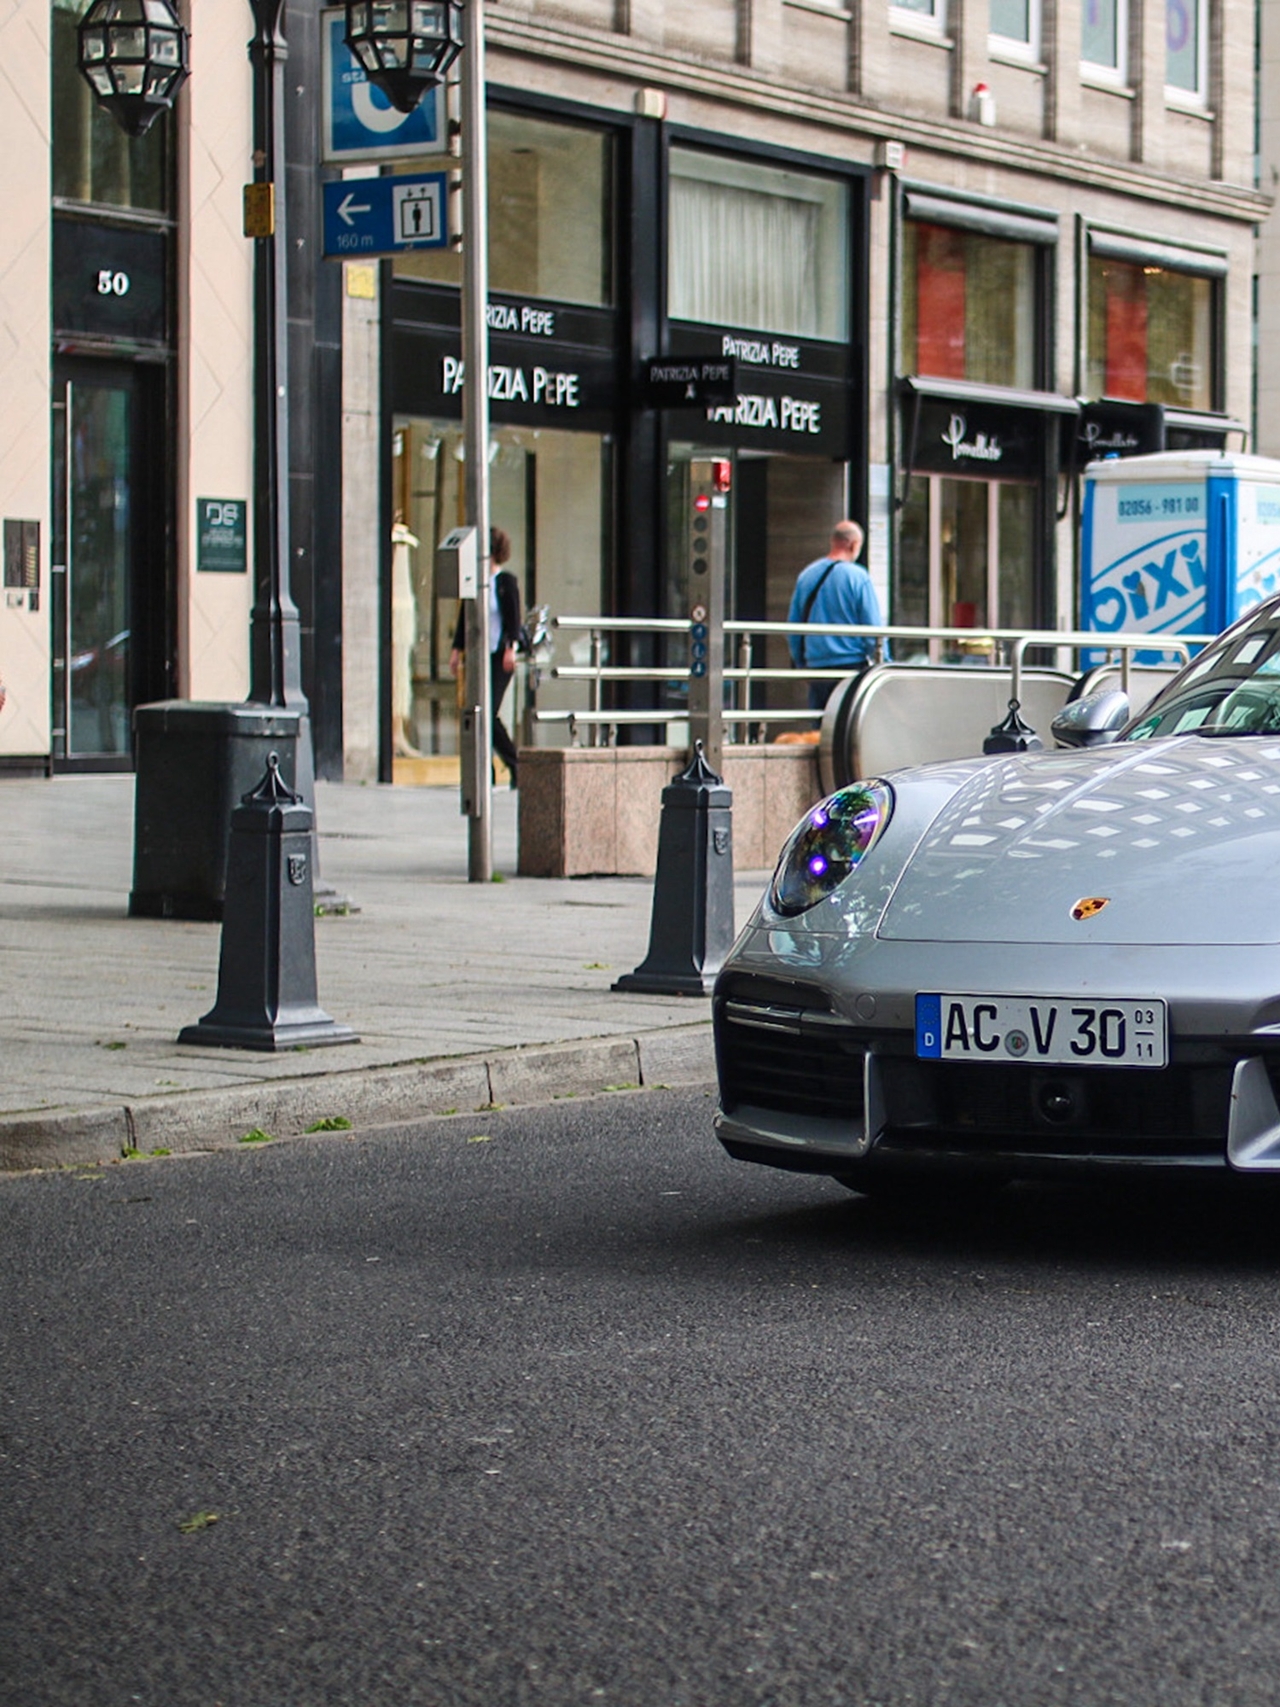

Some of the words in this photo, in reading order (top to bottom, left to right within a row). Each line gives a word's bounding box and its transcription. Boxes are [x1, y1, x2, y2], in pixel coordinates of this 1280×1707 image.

[337, 232, 358, 248] 160
[98, 269, 129, 296] 50
[521, 306, 554, 336] PEPE
[722, 334, 769, 366] PATRIZIA
[772, 341, 799, 369] PEPE
[442, 355, 529, 402] PAIZIA
[533, 366, 579, 408] PEPE
[650, 366, 698, 382] PATRIZIA
[702, 364, 730, 380] PEPE
[780, 395, 821, 434] PEPE
[1119, 499, 1152, 516] 02056
[1162, 499, 1182, 514] 981
[1185, 497, 1199, 512] 00
[1134, 1010, 1154, 1024] 03
[924, 1033, 934, 1046] D
[945, 1003, 1000, 1051] AC
[1030, 1007, 1057, 1054] V
[1070, 1009, 1126, 1057] 30
[1136, 1043, 1153, 1057] 11
